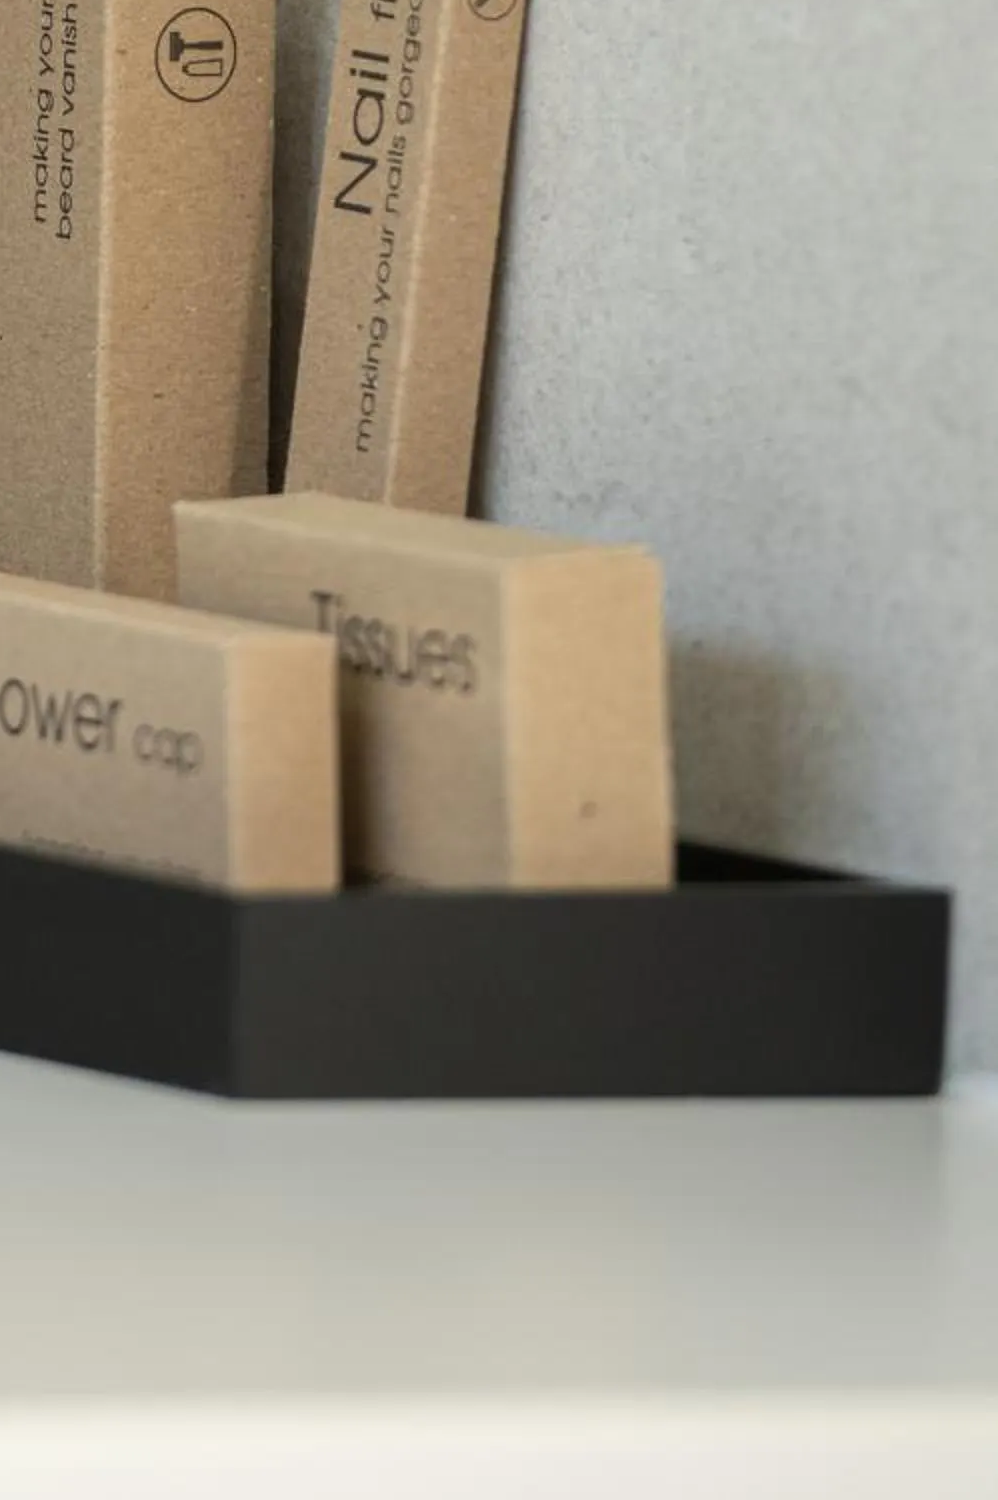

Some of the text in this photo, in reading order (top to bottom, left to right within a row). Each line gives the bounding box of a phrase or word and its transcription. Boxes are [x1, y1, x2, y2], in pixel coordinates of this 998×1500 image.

[33, 88, 55, 224] making
[55, 2, 79, 240] beard vanish
[333, 47, 391, 217] Nail
[384, 135, 407, 218] nails
[373, 226, 397, 309] your
[355, 315, 389, 453] making
[309, 588, 479, 696] Tissues
[131, 722, 202, 777] cap
